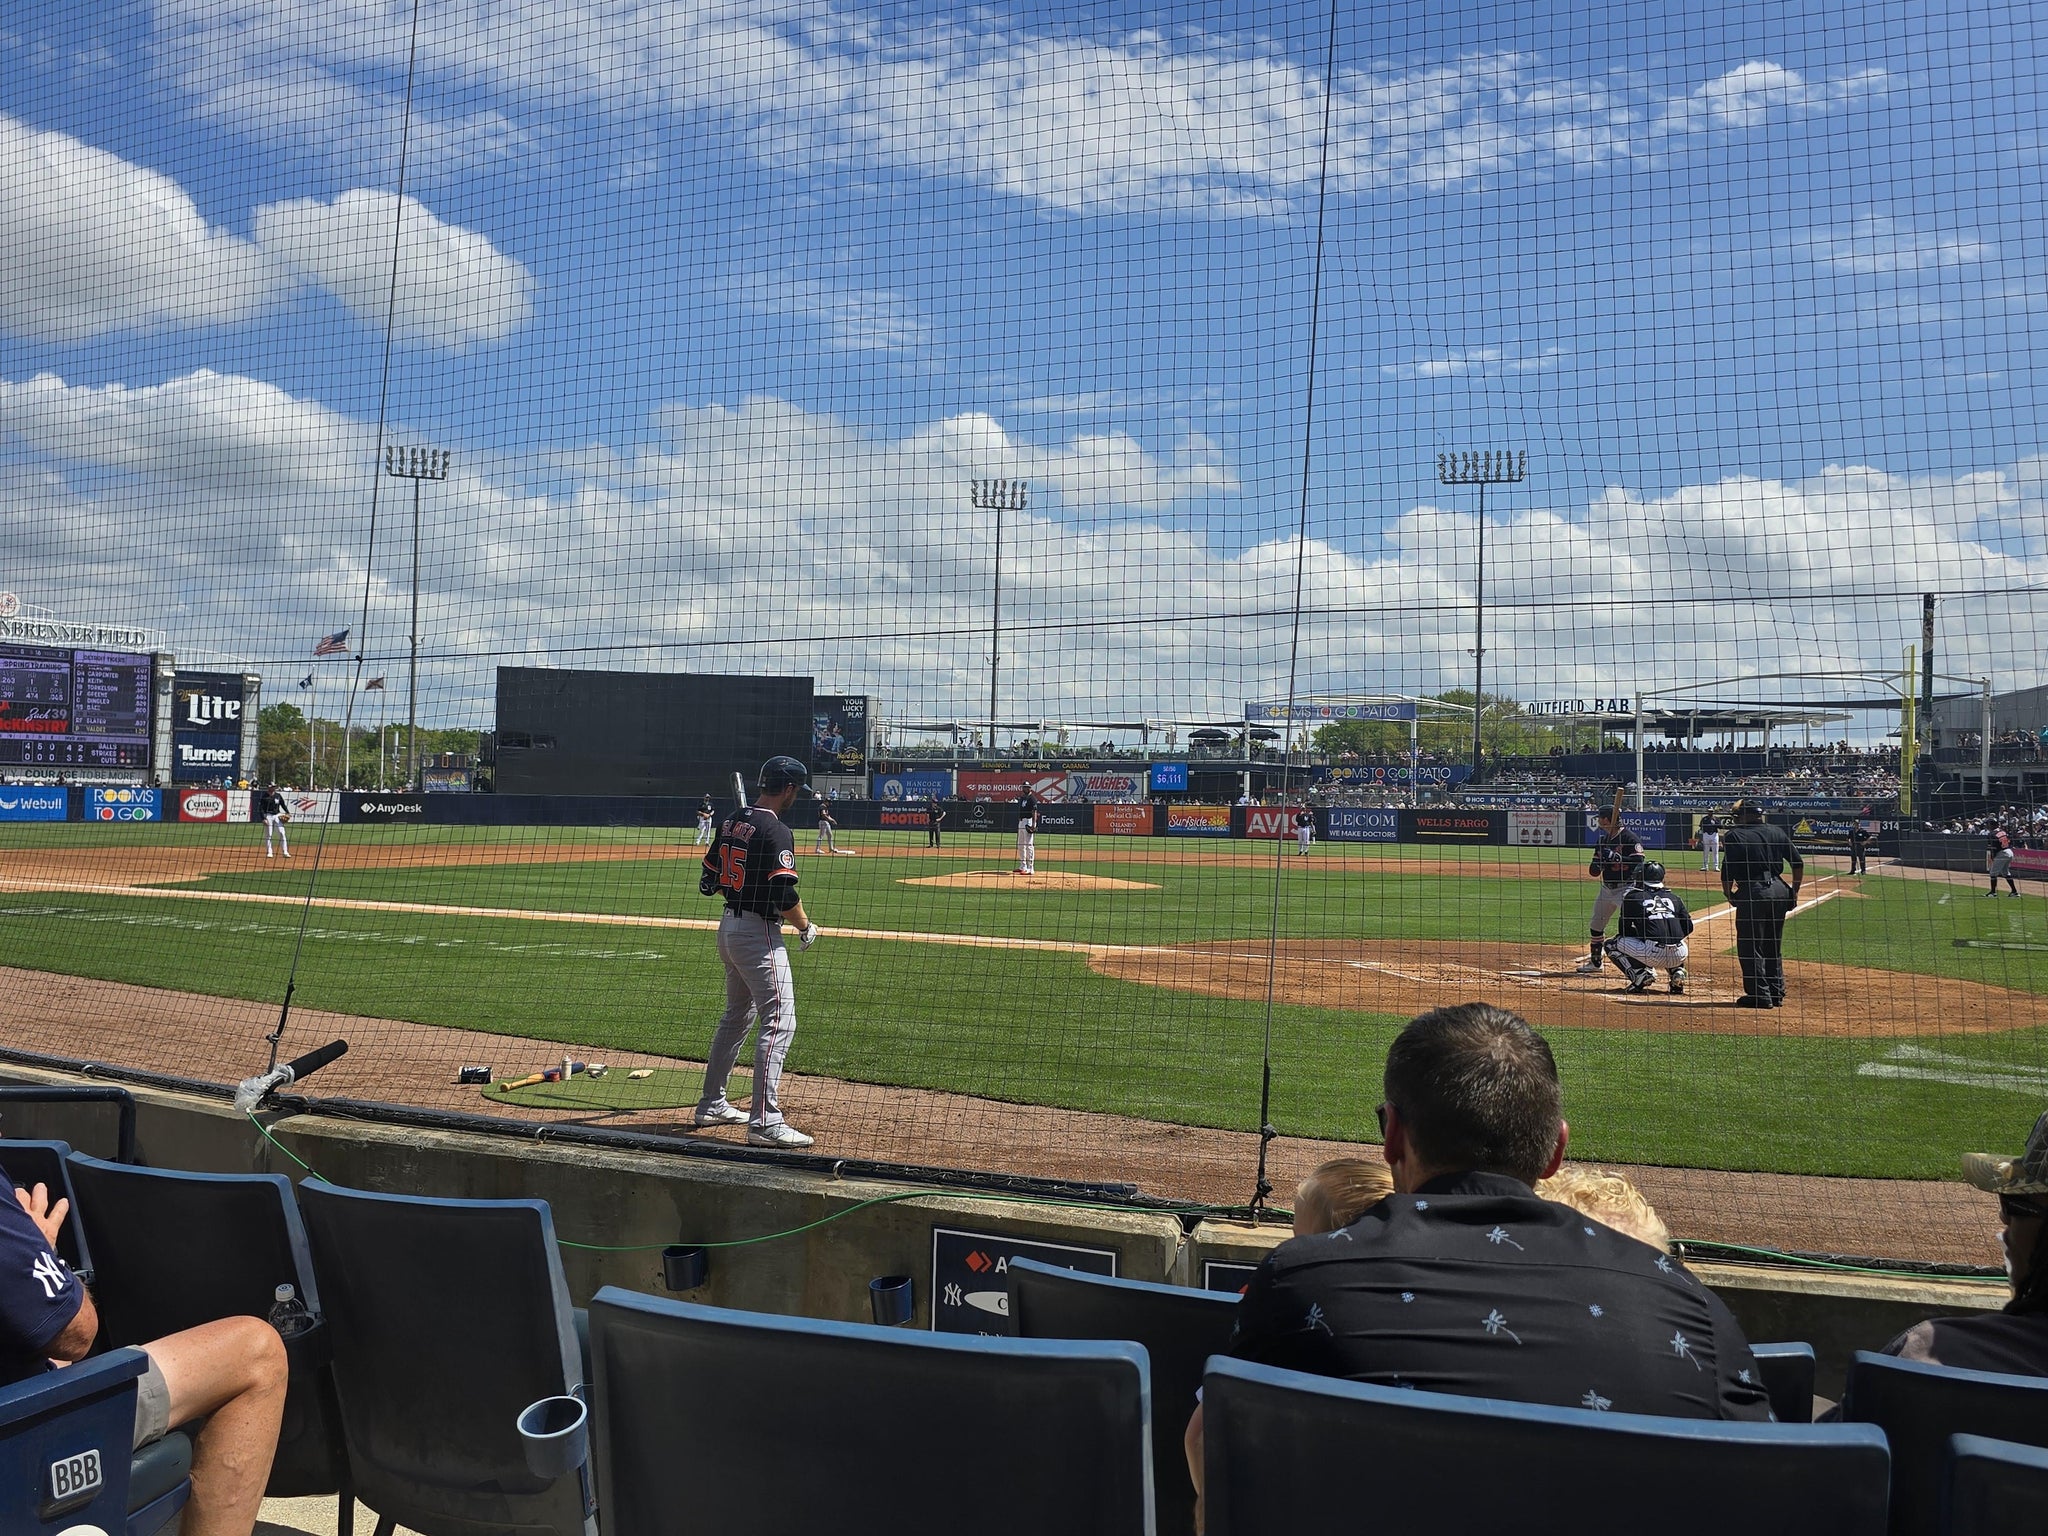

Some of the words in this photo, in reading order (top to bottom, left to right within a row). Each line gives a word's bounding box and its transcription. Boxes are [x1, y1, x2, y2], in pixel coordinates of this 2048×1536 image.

[97, 629, 146, 645] FIELD
[187, 694, 240, 725] Lite
[1315, 706, 1331, 718] TO
[1335, 706, 1358, 717] GO
[1362, 706, 1399, 717] PATIO
[1528, 699, 1585, 715] OUTFIELD
[1594, 698, 1629, 712] BAR
[52, 708, 67, 719] 39
[25, 742, 30, 750] 4
[78, 744, 84, 752] 2
[78, 754, 84, 762] 2
[178, 744, 236, 762] Turner
[25, 770, 78, 778] COURAGE
[80, 770, 95, 778] TO
[109, 772, 135, 780] MORE
[1325, 767, 1368, 778] ROOMS
[1370, 767, 1386, 778] TO
[1388, 767, 1408, 778] GO
[1418, 768, 1451, 778] PATIO
[906, 780, 942, 788] HANCOCK
[1087, 776, 1129, 790] HUGHES
[1157, 774, 1182, 784] $6,111
[992, 784, 1022, 792] HOUSING
[94, 788, 154, 802] ROOMS
[1471, 796, 1485, 804] HCC
[1522, 796, 1535, 804] HCC
[21, 798, 62, 810] Webull
[186, 800, 220, 810] Century
[376, 803, 422, 814] AnyDesk
[94, 806, 115, 820] TO
[118, 806, 146, 820] GO
[1042, 816, 1074, 825] Fanatics
[1168, 814, 1208, 828] Surfside
[1416, 818, 1452, 828] WELLS
[1454, 818, 1489, 828] FARGO
[1644, 818, 1666, 826] LAW
[1816, 820, 1830, 828] Your
[1830, 820, 1846, 828] First
[1882, 820, 1900, 830] 314
[1362, 830, 1396, 838] DOCTORS
[720, 843, 748, 892] 15
[32, 1251, 66, 1298] NY
[943, 1282, 963, 1307] NY
[55, 1454, 98, 1496] BBB
